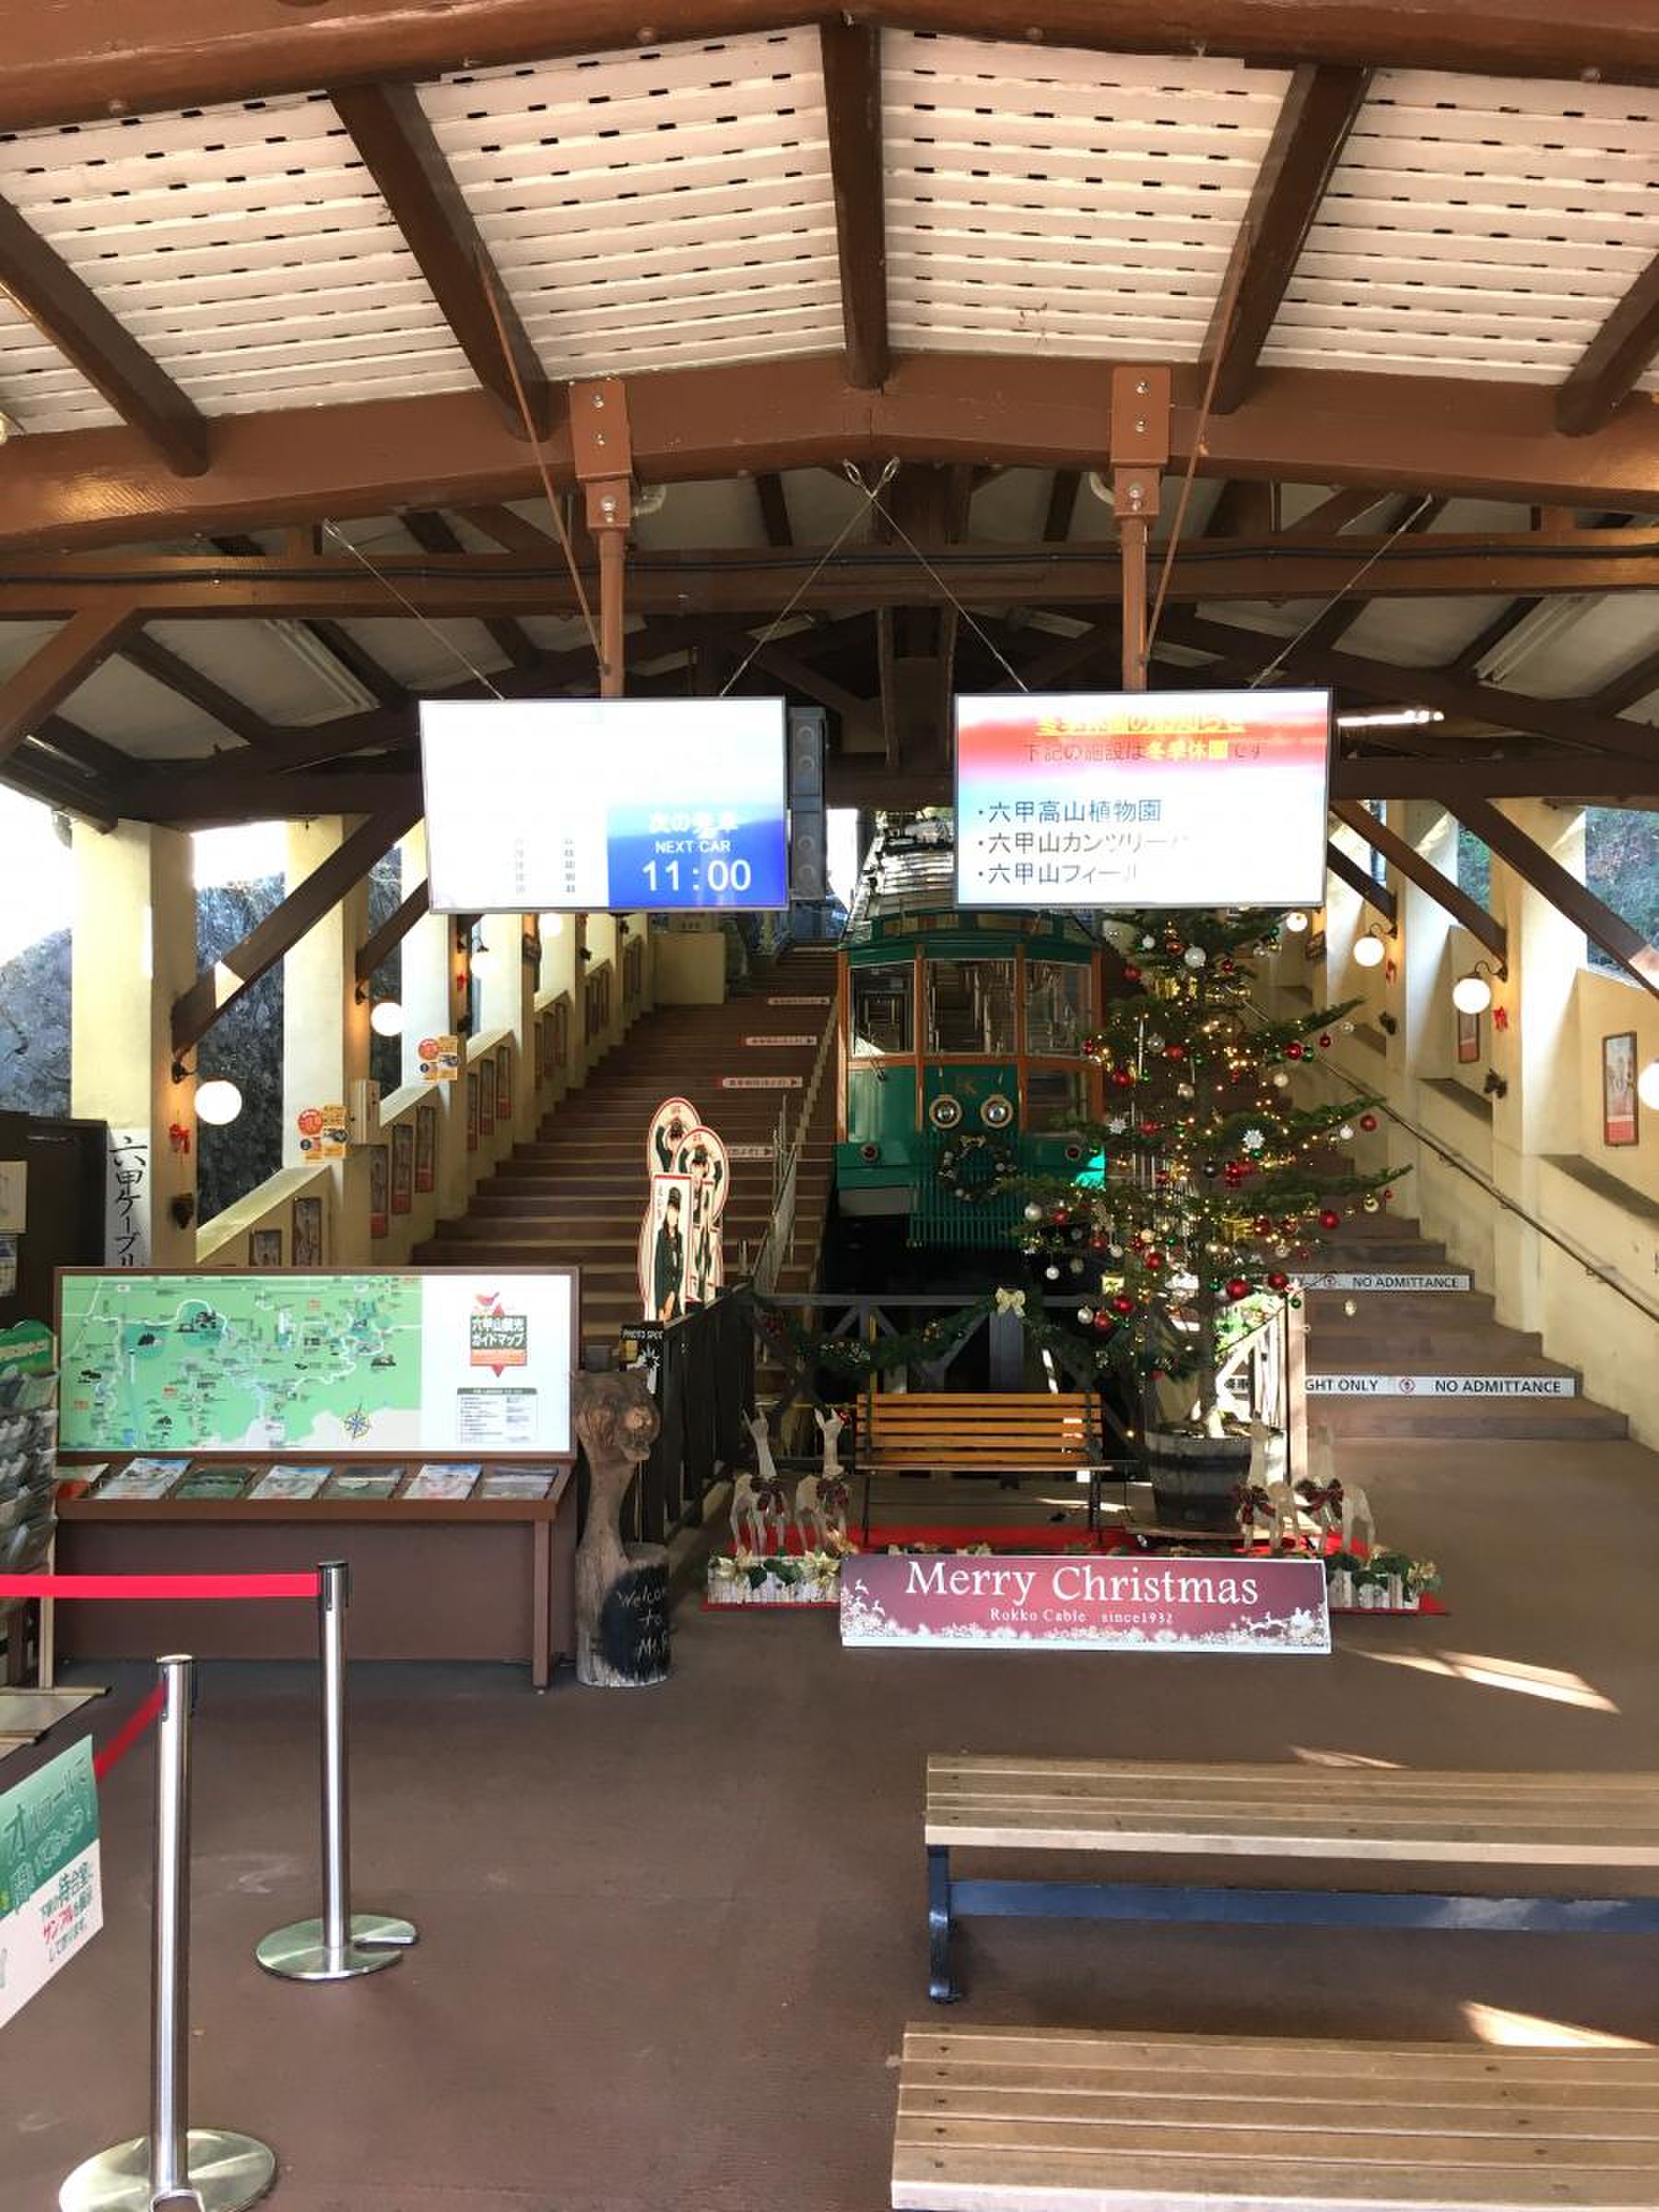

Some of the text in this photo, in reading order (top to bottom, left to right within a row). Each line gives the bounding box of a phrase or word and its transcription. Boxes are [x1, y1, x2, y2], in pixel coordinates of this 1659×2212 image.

[655, 840, 732, 853] NEXT CAR
[642, 860, 752, 891] 11:00
[1352, 1277, 1459, 1288] NO ADMITTANCE
[1304, 1378, 1379, 1392] GHT ONLY
[1434, 1380, 1561, 1394] NO ADMITTANCE
[905, 1560, 1259, 1606] Merry Christmas
[990, 1607, 1038, 1621] Rokko
[1044, 1608, 1088, 1622] Cable
